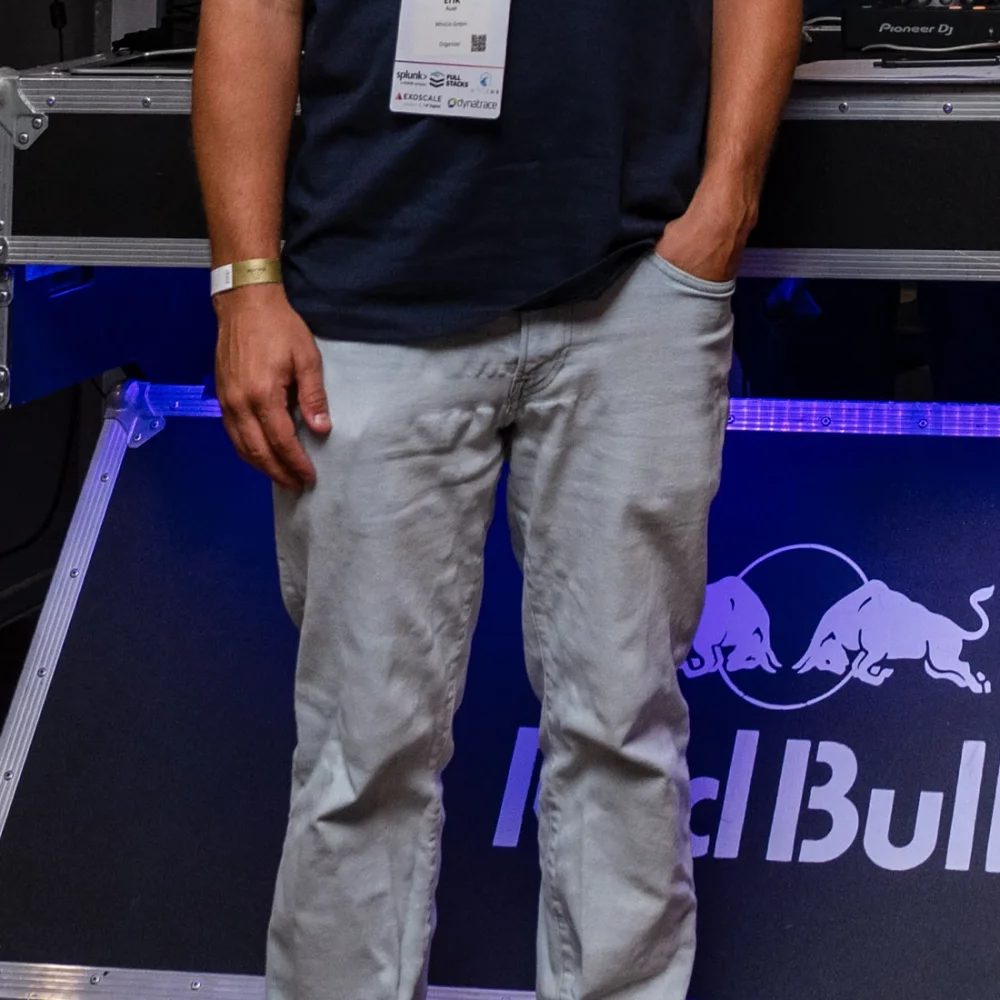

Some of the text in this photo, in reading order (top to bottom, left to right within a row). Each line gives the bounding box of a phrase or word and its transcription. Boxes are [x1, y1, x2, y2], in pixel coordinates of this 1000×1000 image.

[878, 22, 936, 33] Pioneer
[445, 80, 469, 88] STACKS
[403, 92, 443, 102] EXOSCALE
[456, 98, 498, 110] dynatrace
